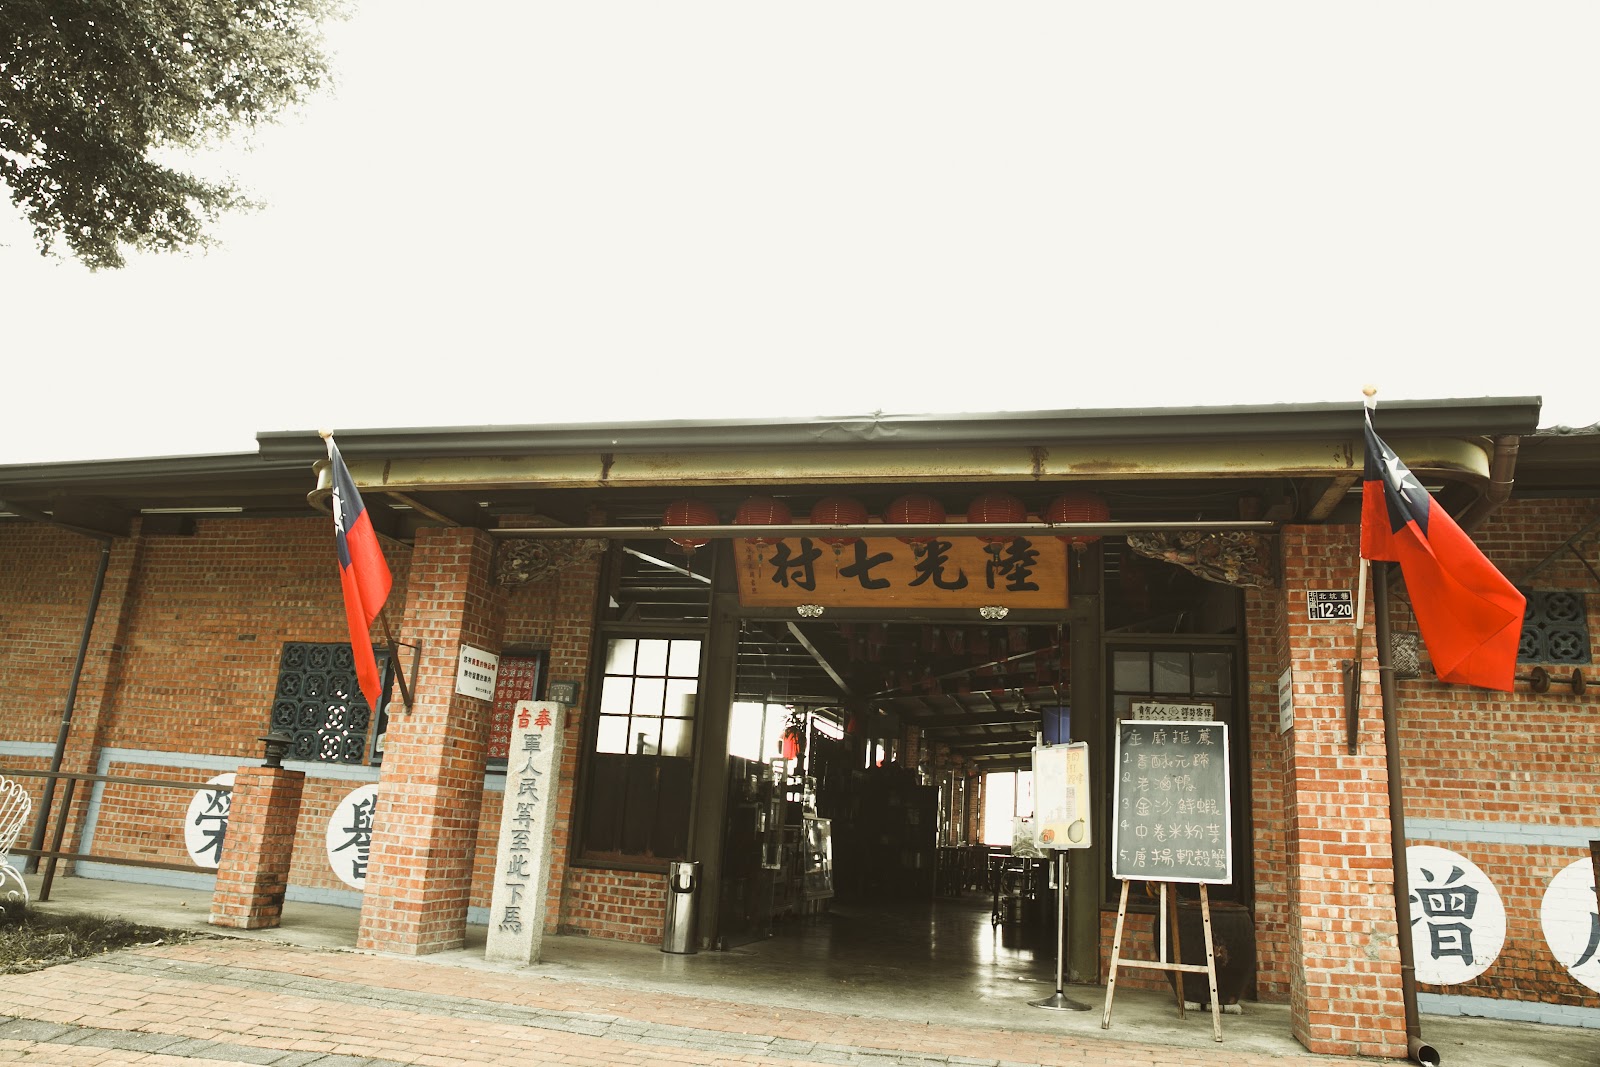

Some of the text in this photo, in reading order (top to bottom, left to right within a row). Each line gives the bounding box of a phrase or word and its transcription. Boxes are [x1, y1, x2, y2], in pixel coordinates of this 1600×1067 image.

[1129, 728, 1214, 746] 主廚推薦
[1136, 774, 1197, 792] 老滷鴨
[1135, 796, 1223, 817] 金沙鮮蝦
[499, 733, 543, 934] 軍人民等至此下馬
[1132, 847, 1227, 868] 唐揚軟殼蟹
